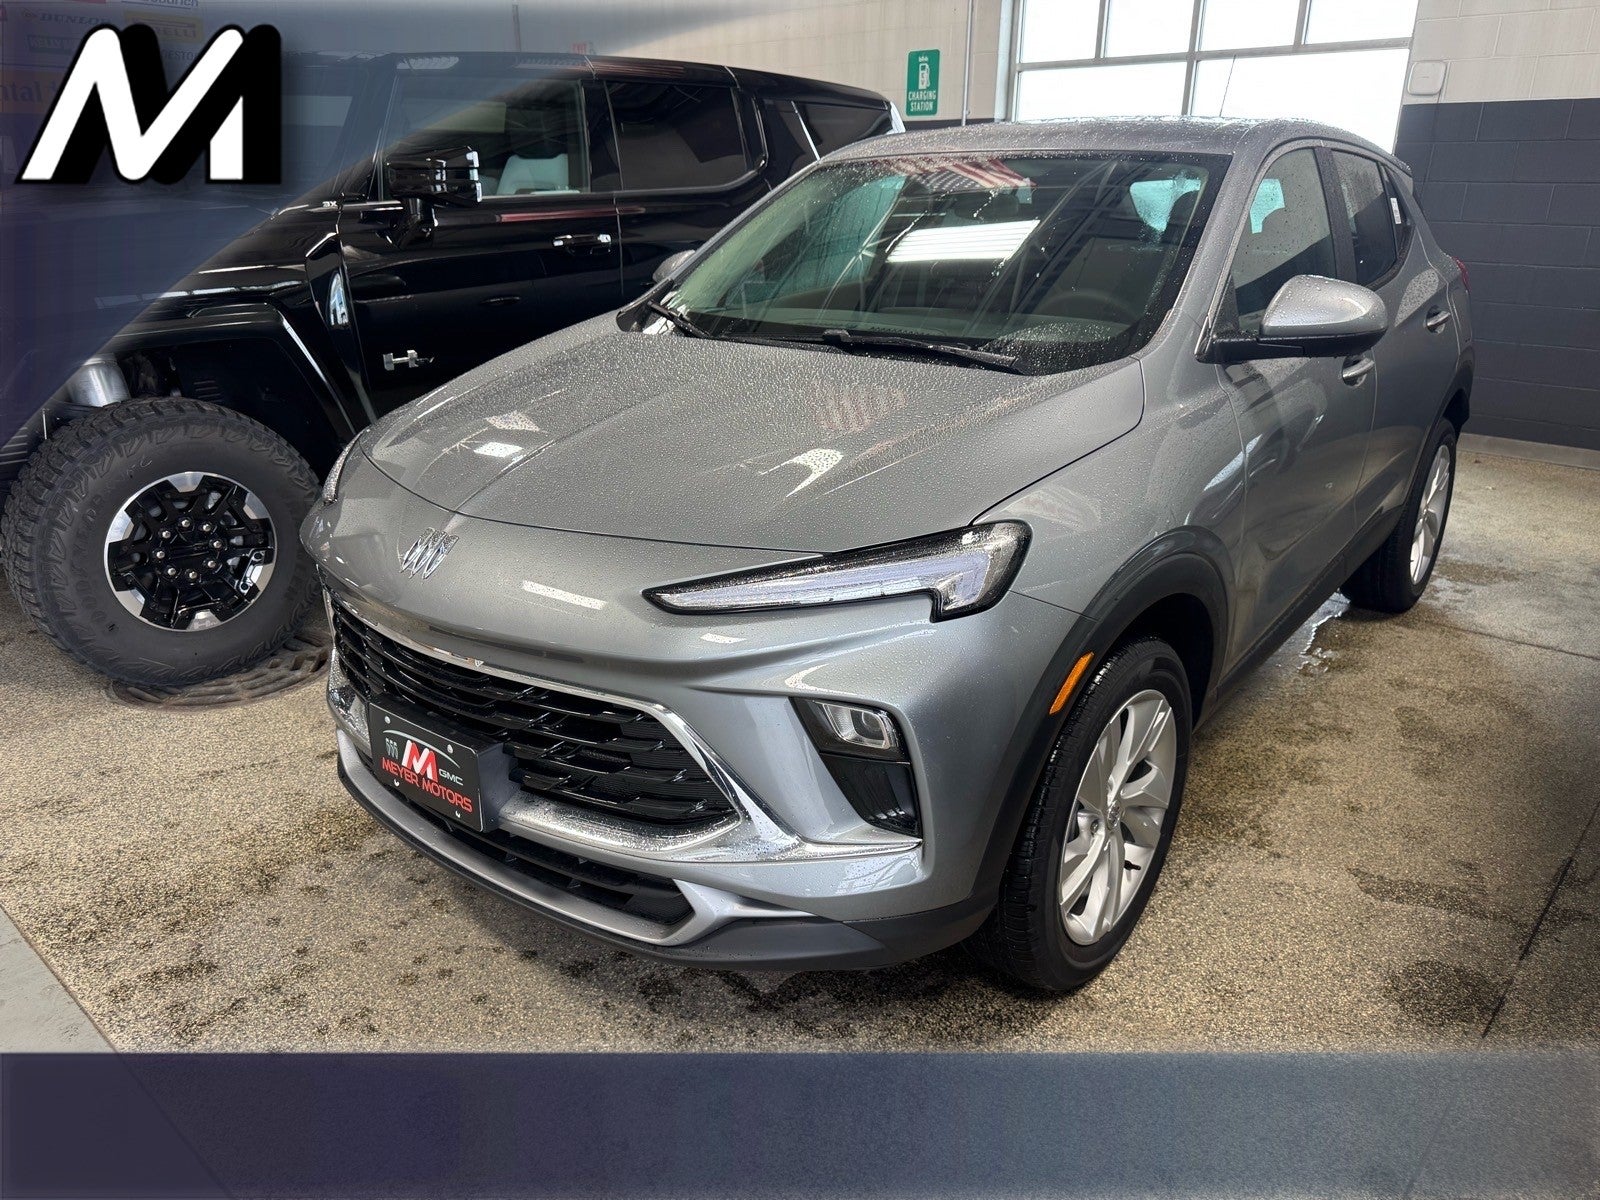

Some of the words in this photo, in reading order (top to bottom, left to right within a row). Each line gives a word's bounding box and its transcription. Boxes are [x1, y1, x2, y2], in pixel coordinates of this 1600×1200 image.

[908, 90, 936, 101] CHARGING
[910, 101, 933, 112] STATION
[438, 768, 464, 786] GMC
[382, 757, 419, 788] MEYER
[422, 778, 473, 813] MOTORS
